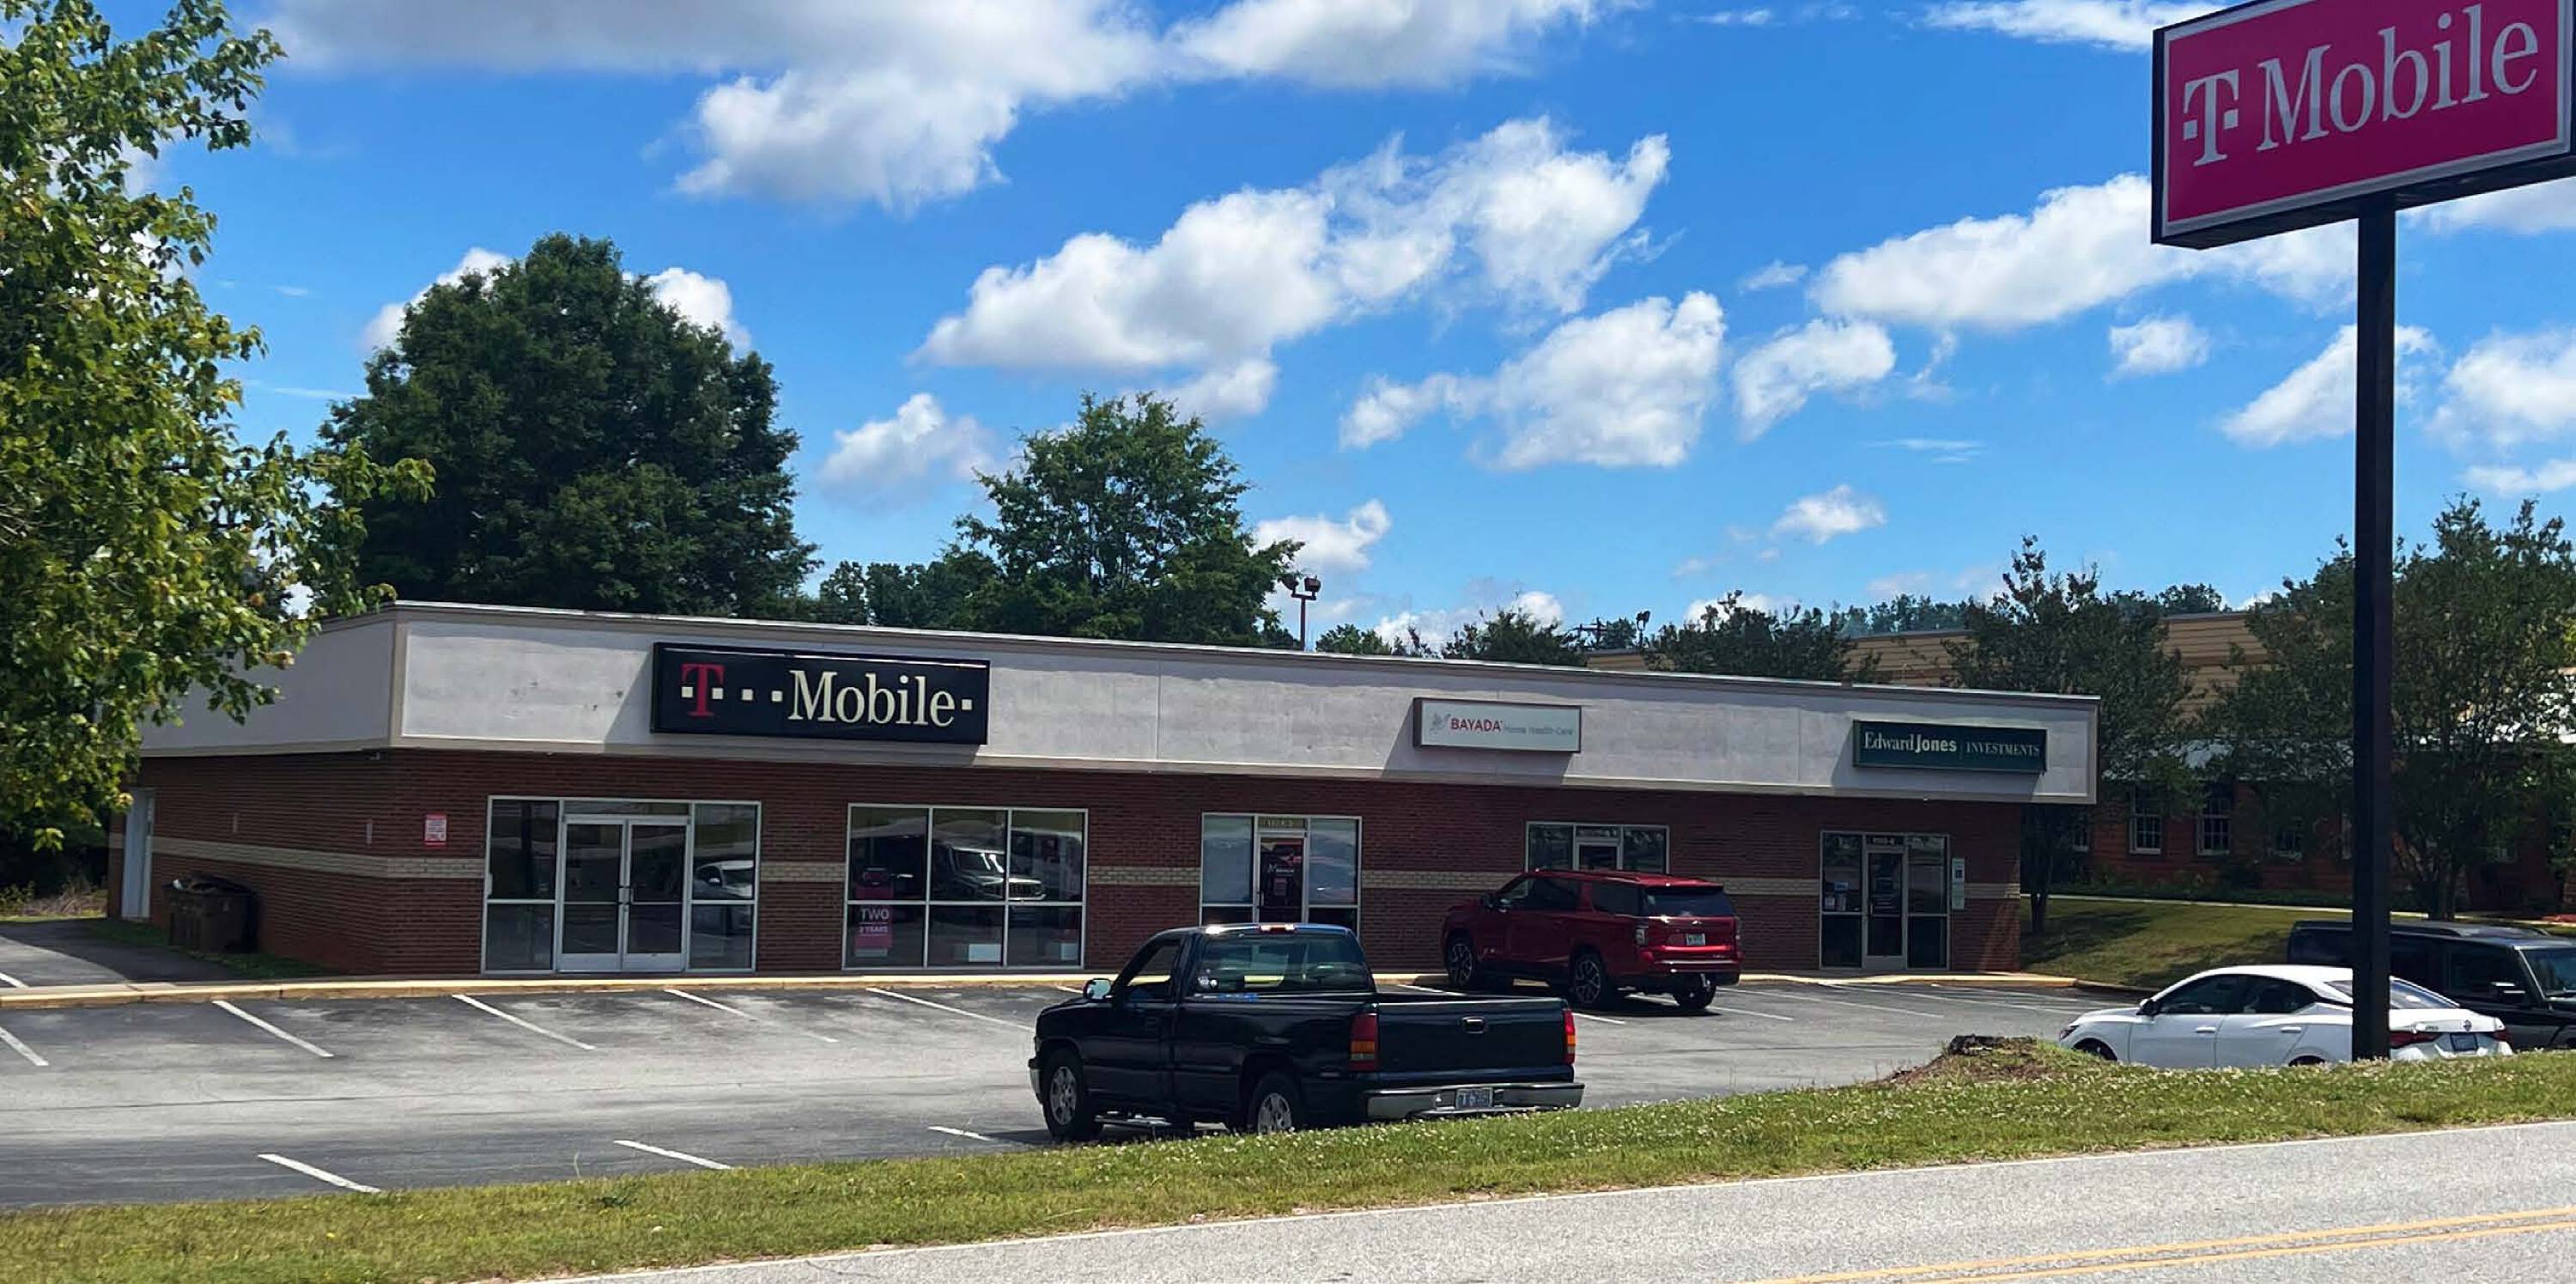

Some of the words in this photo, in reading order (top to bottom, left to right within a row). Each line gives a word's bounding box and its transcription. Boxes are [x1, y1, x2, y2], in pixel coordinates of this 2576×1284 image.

[2257, 3, 2539, 152] Mobile
[787, 670, 956, 727] Mobile
[1450, 718, 1501, 733] BAYADA
[1965, 741, 2041, 758] INVESTMENTS
[860, 907, 890, 920] TWO
